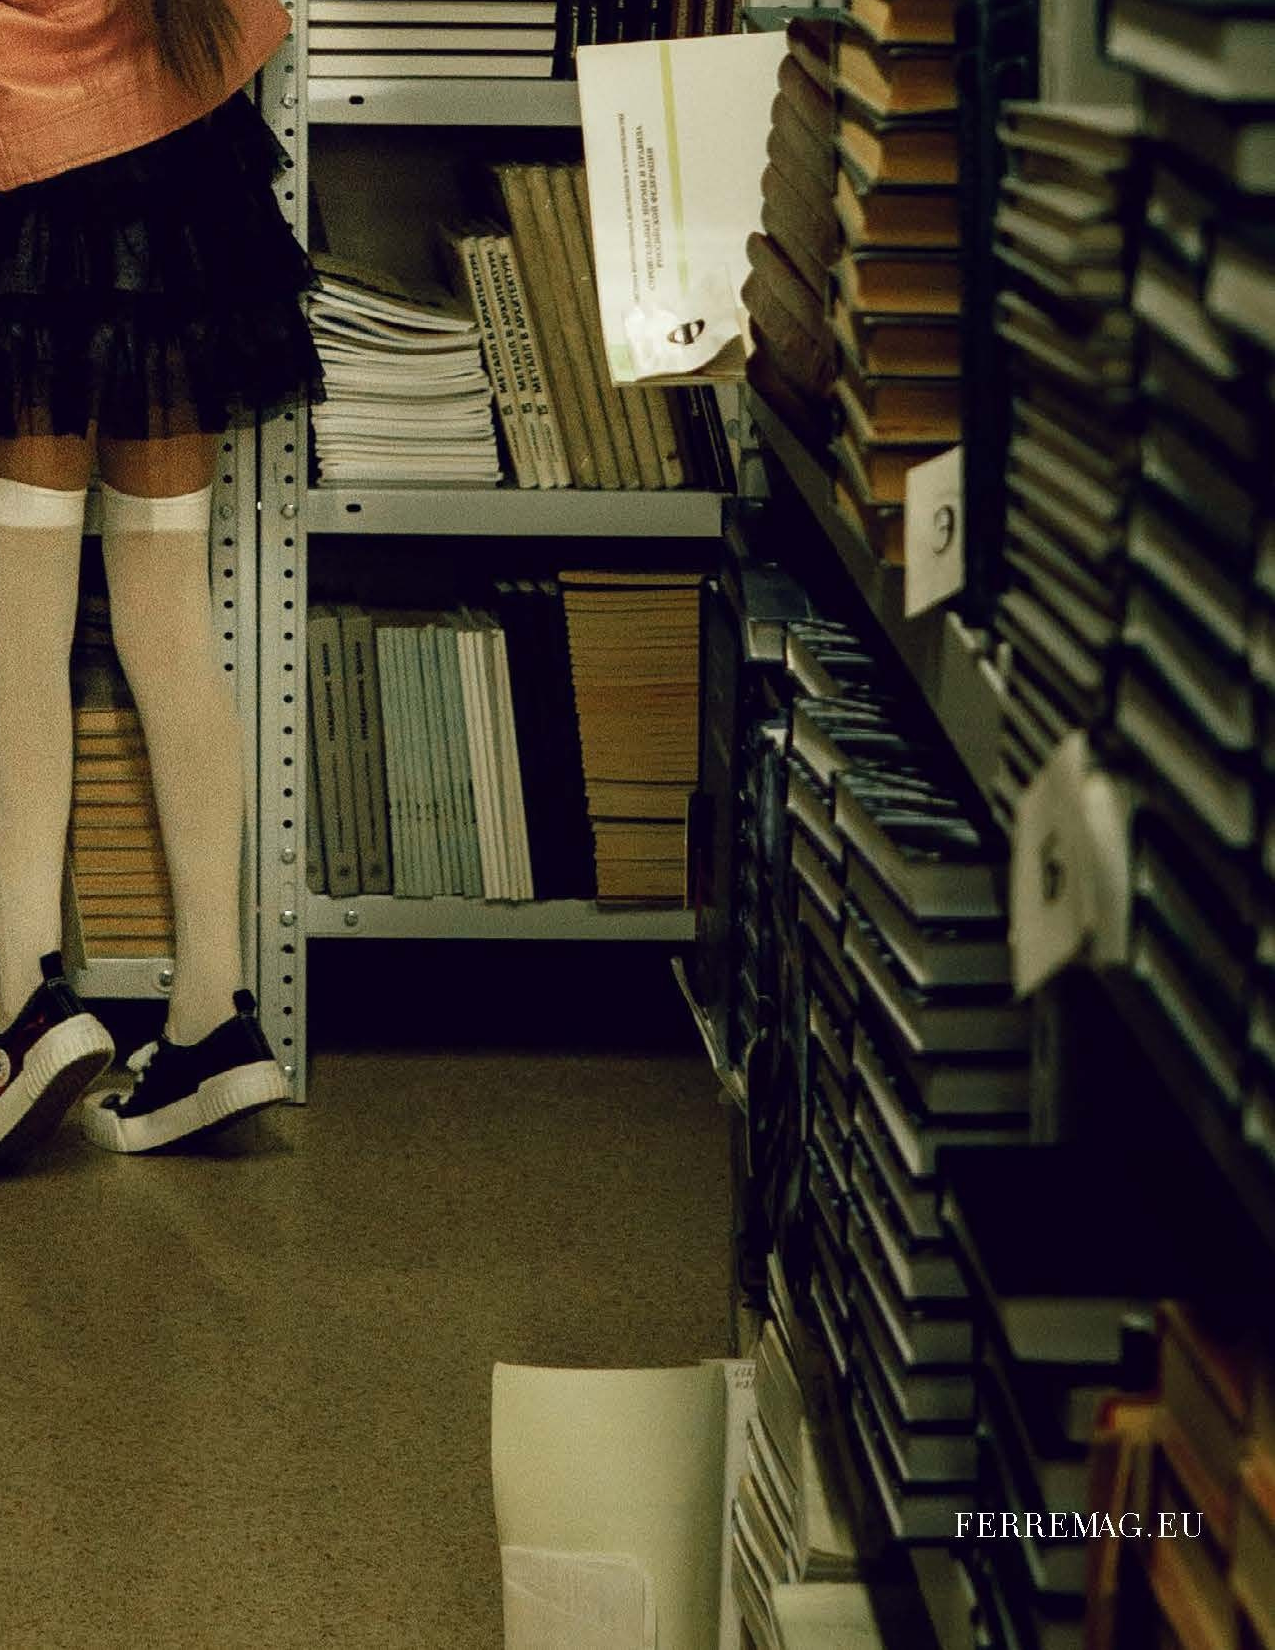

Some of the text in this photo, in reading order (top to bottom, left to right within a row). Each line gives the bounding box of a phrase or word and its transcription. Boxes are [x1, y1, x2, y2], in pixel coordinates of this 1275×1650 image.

[469, 253, 508, 393] МЕТАЛЛ В АРХИТЕКТУРЕ
[488, 250, 527, 392] МЕТАЛЛ В АРХИТЕКТУРЕ
[501, 253, 542, 393] МЕТАЛЛ В АРХИТЕКТУРЕ
